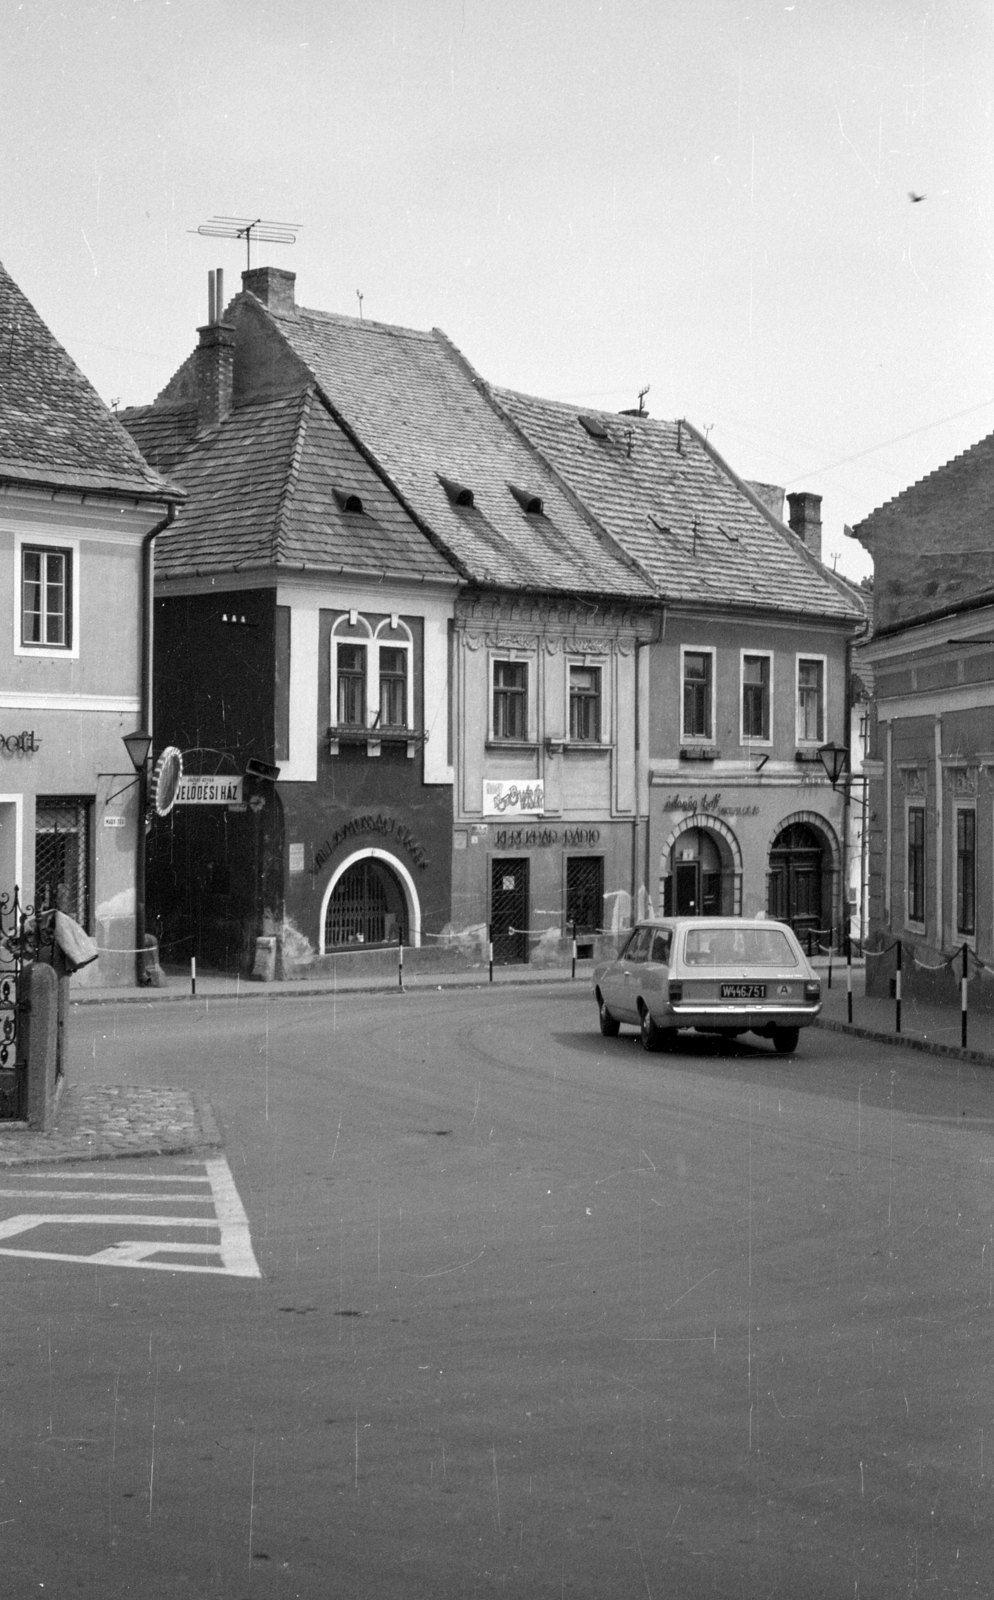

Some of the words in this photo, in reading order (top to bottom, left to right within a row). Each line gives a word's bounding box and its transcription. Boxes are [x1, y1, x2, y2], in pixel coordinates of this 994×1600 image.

[176, 781, 219, 801] VELŐDÉSI
[221, 781, 238, 801] HÁZ
[780, 985, 788, 994] A
